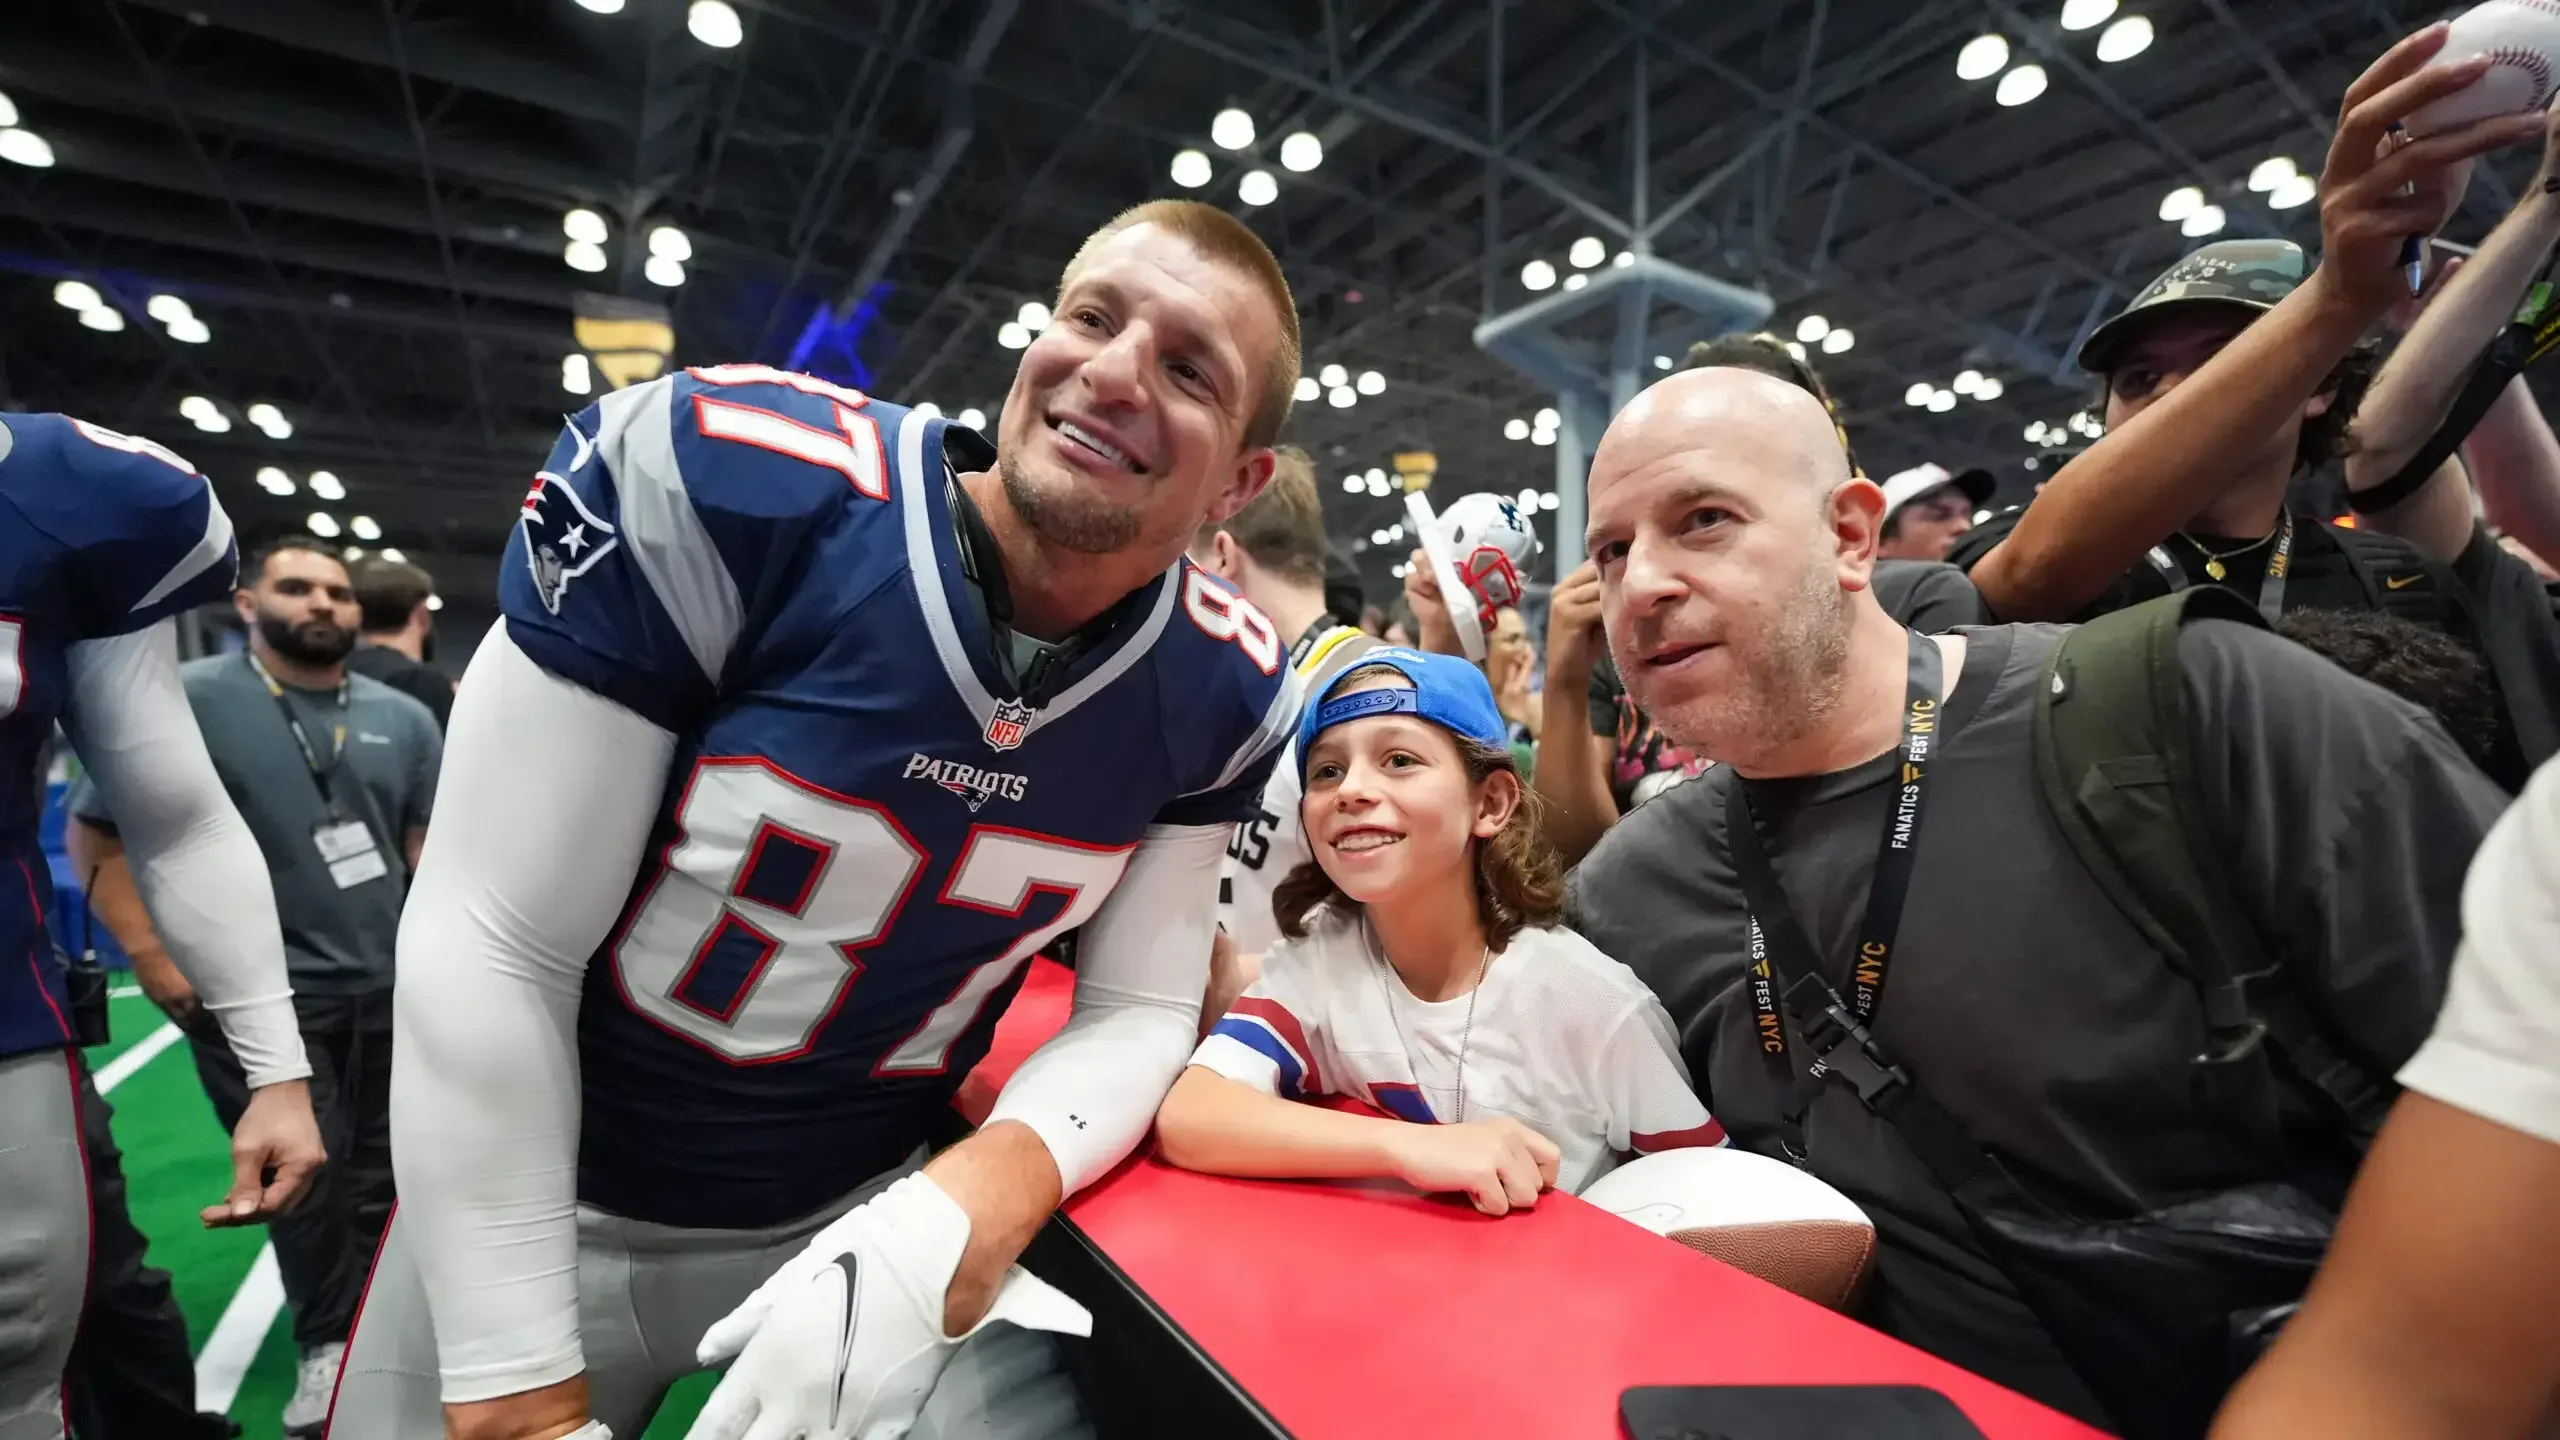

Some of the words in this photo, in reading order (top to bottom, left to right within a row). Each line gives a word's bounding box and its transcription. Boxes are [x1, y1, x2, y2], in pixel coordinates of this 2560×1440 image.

[2269, 552, 2288, 578] NYC
[1182, 563, 1281, 676] 8
[989, 719, 1021, 744] NFL
[1910, 699, 1937, 733] NYC
[1909, 734, 1929, 762] FEST
[902, 752, 1029, 802] PATRIOTS
[1892, 784, 1921, 849] FANATICS
[608, 756, 1137, 1077] 87
[1856, 941, 1887, 985] NYC
[1755, 980, 1773, 1012] FEST
[1856, 984, 1874, 1017] FEST
[1758, 1013, 1784, 1053] NYC
